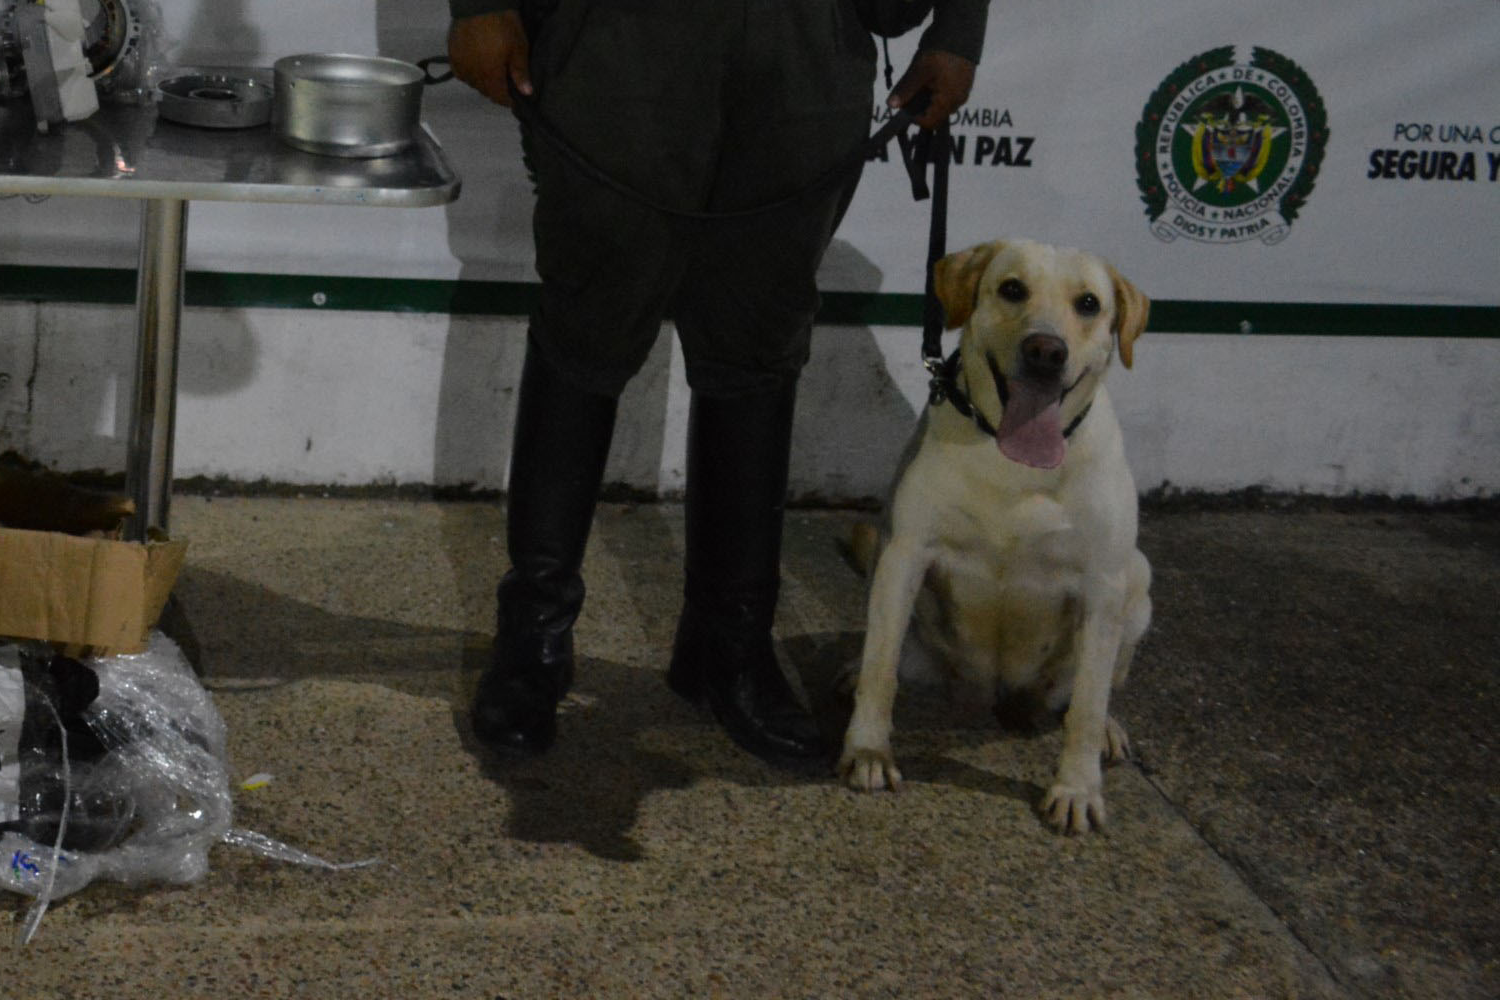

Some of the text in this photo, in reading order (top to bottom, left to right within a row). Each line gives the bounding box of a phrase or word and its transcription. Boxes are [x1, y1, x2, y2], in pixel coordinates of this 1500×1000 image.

[1233, 68, 1253, 79] DE
[1268, 79, 1304, 157] COLOMBIA
[1394, 123, 1433, 142] POR
[1439, 125, 1483, 142] UNA
[974, 136, 1036, 166] PAZ
[1368, 150, 1476, 180] SEGURA
[1224, 176, 1293, 219] NACIONAL
[1221, 218, 1269, 238] PATRIA
